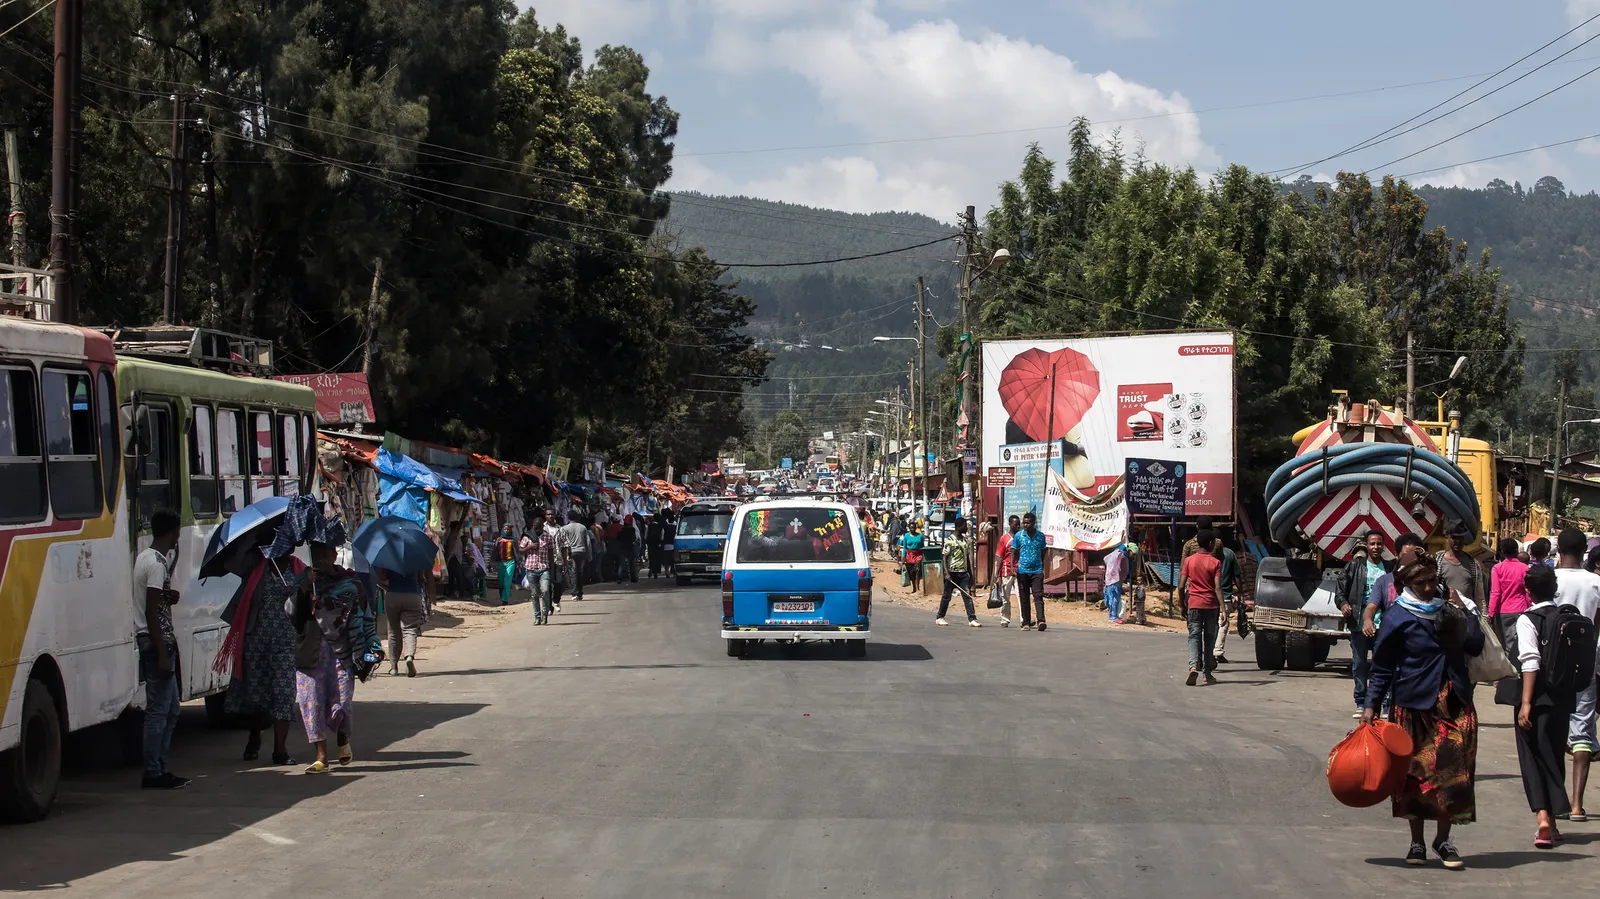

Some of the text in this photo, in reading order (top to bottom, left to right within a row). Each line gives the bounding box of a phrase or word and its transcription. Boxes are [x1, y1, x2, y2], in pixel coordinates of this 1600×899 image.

[317, 374, 343, 388] ደስታ
[1119, 394, 1148, 403] TRUST
[1149, 491, 1175, 500] Technical
[1185, 498, 1213, 506] otection
